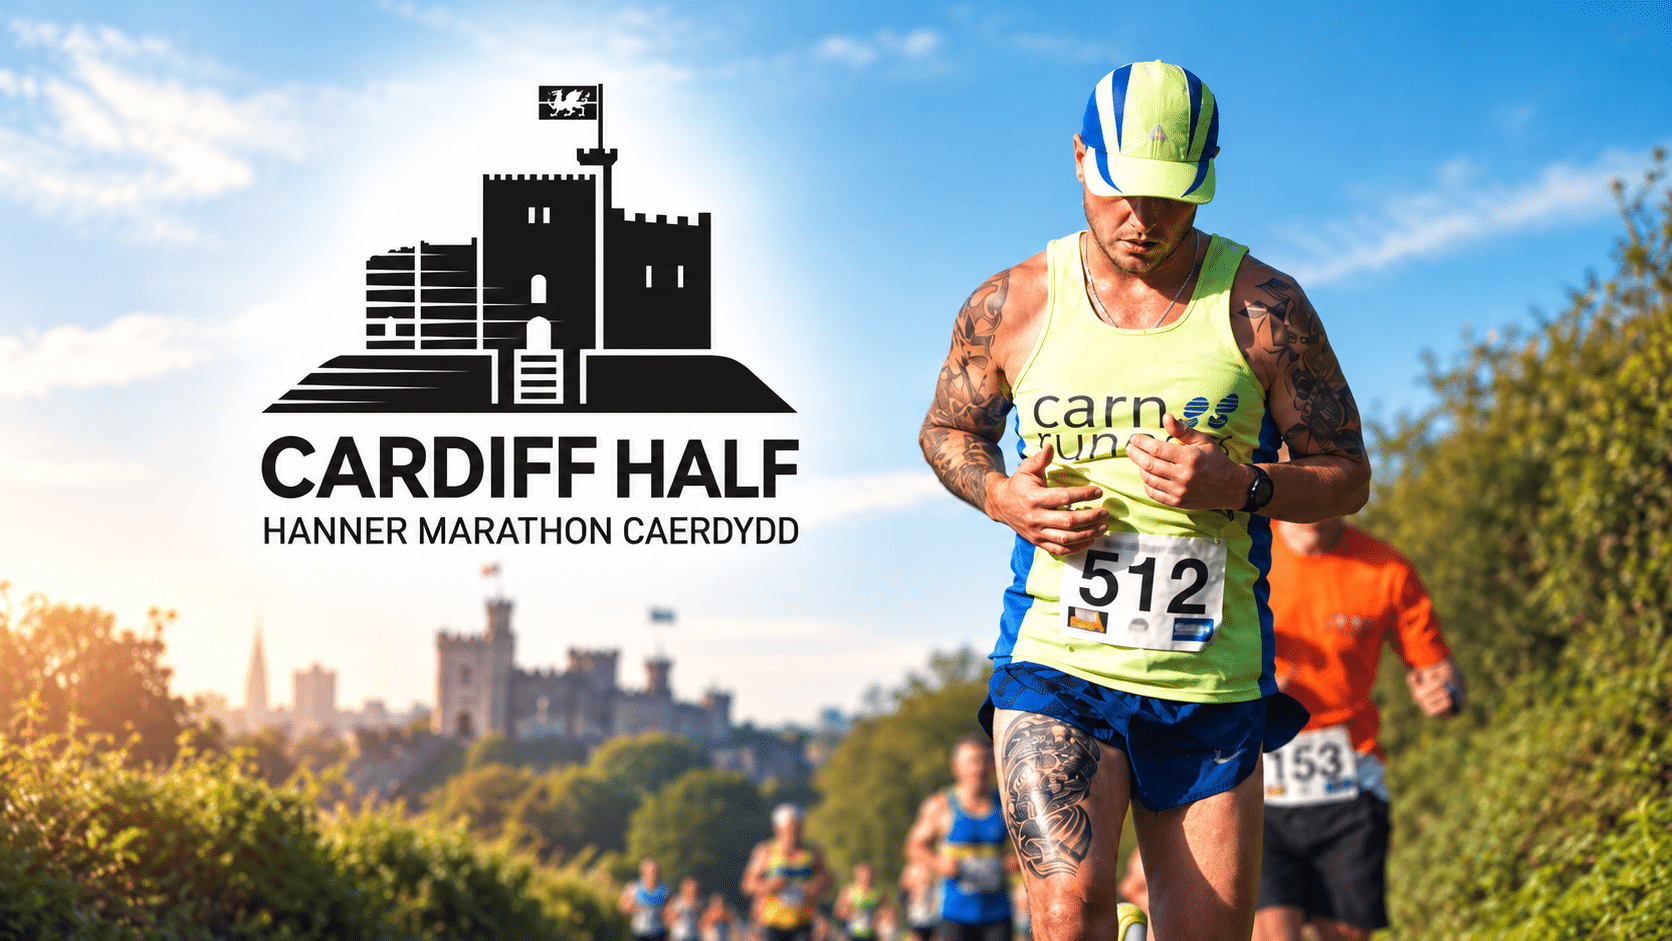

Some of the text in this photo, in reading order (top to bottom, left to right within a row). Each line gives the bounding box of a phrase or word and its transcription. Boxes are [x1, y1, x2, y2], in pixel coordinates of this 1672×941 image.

[1034, 395, 1166, 429] carn
[1078, 548, 1209, 615] 512
[1269, 742, 1343, 782] 153
